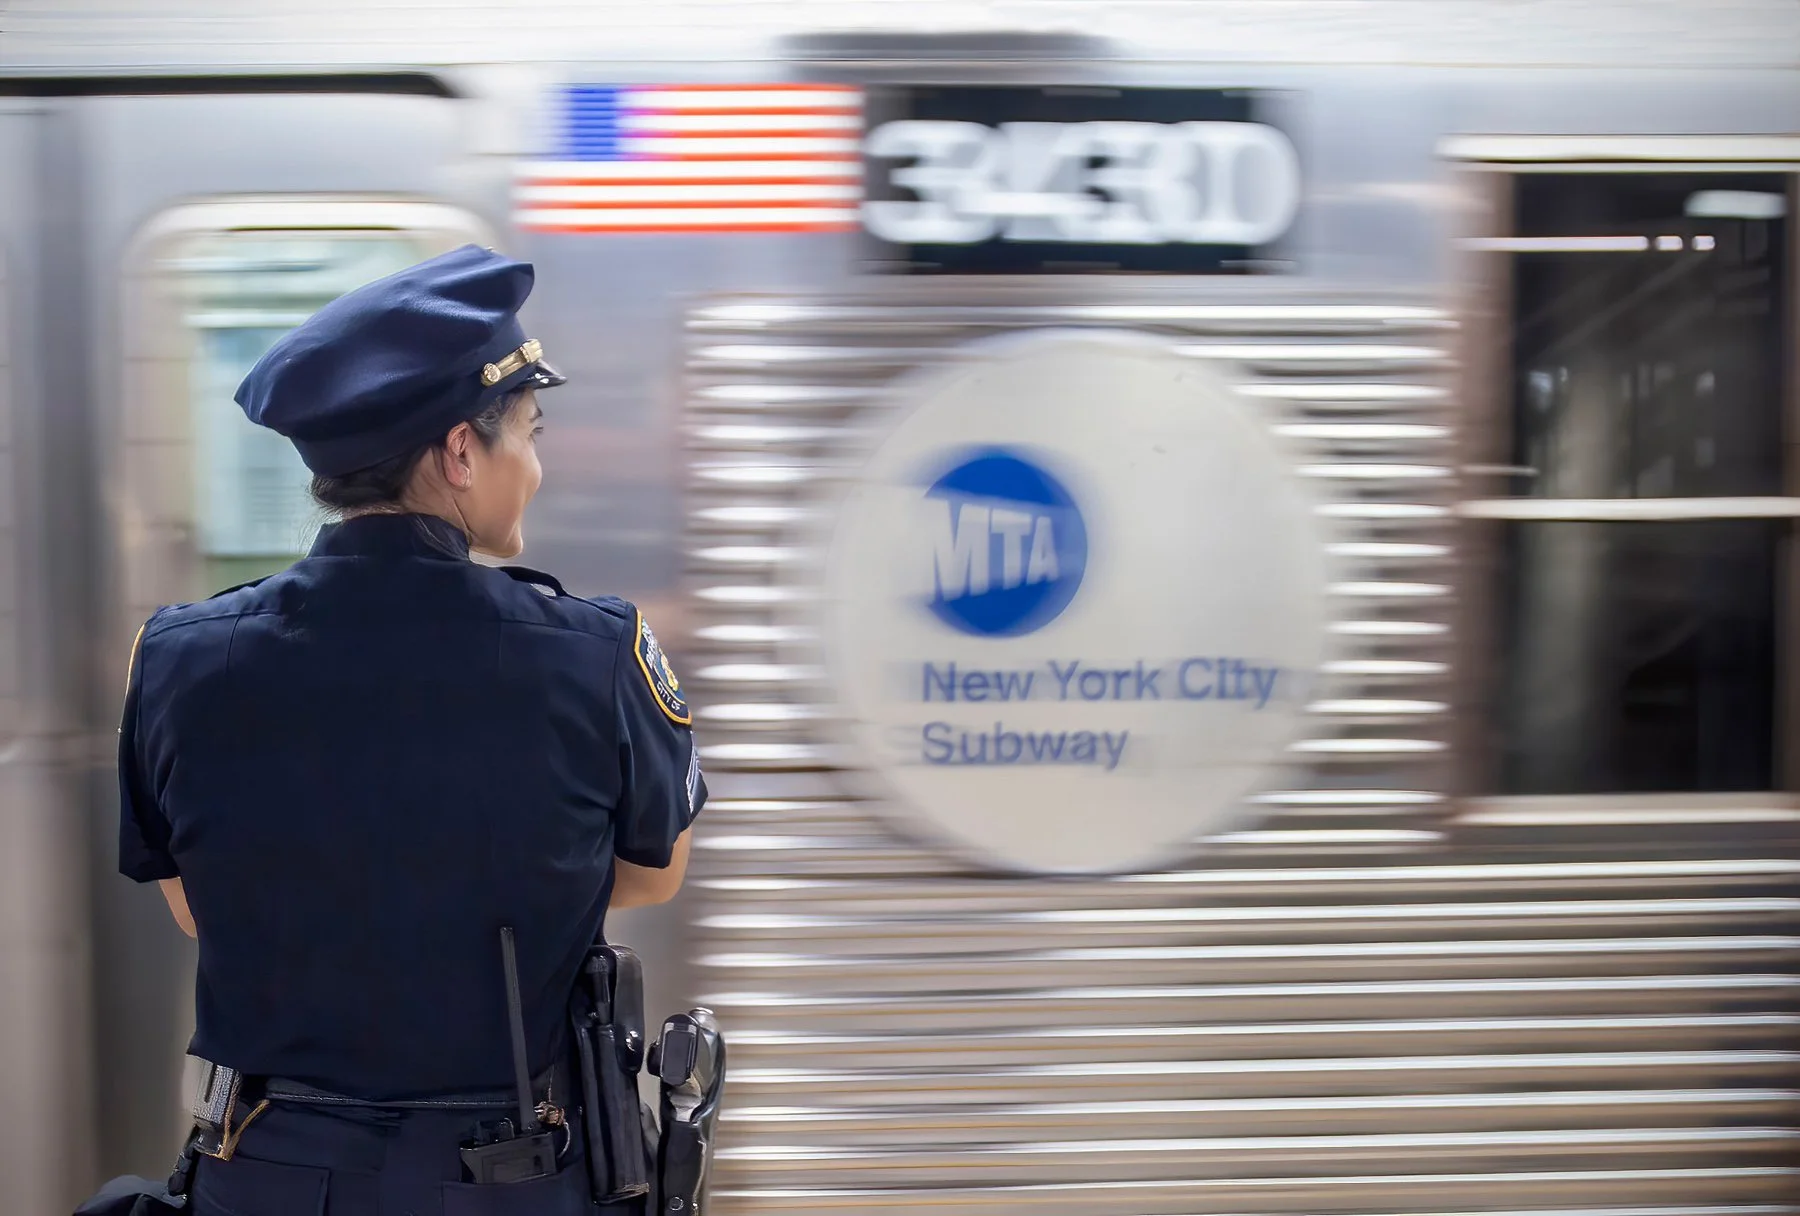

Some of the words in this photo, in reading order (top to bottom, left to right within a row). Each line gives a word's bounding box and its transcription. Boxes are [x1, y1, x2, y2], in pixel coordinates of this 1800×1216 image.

[923, 499, 1060, 602] MTA
[922, 662, 1033, 702] New
[1047, 660, 1160, 701] York
[1178, 657, 1279, 710] City
[922, 721, 1129, 771] Subway
